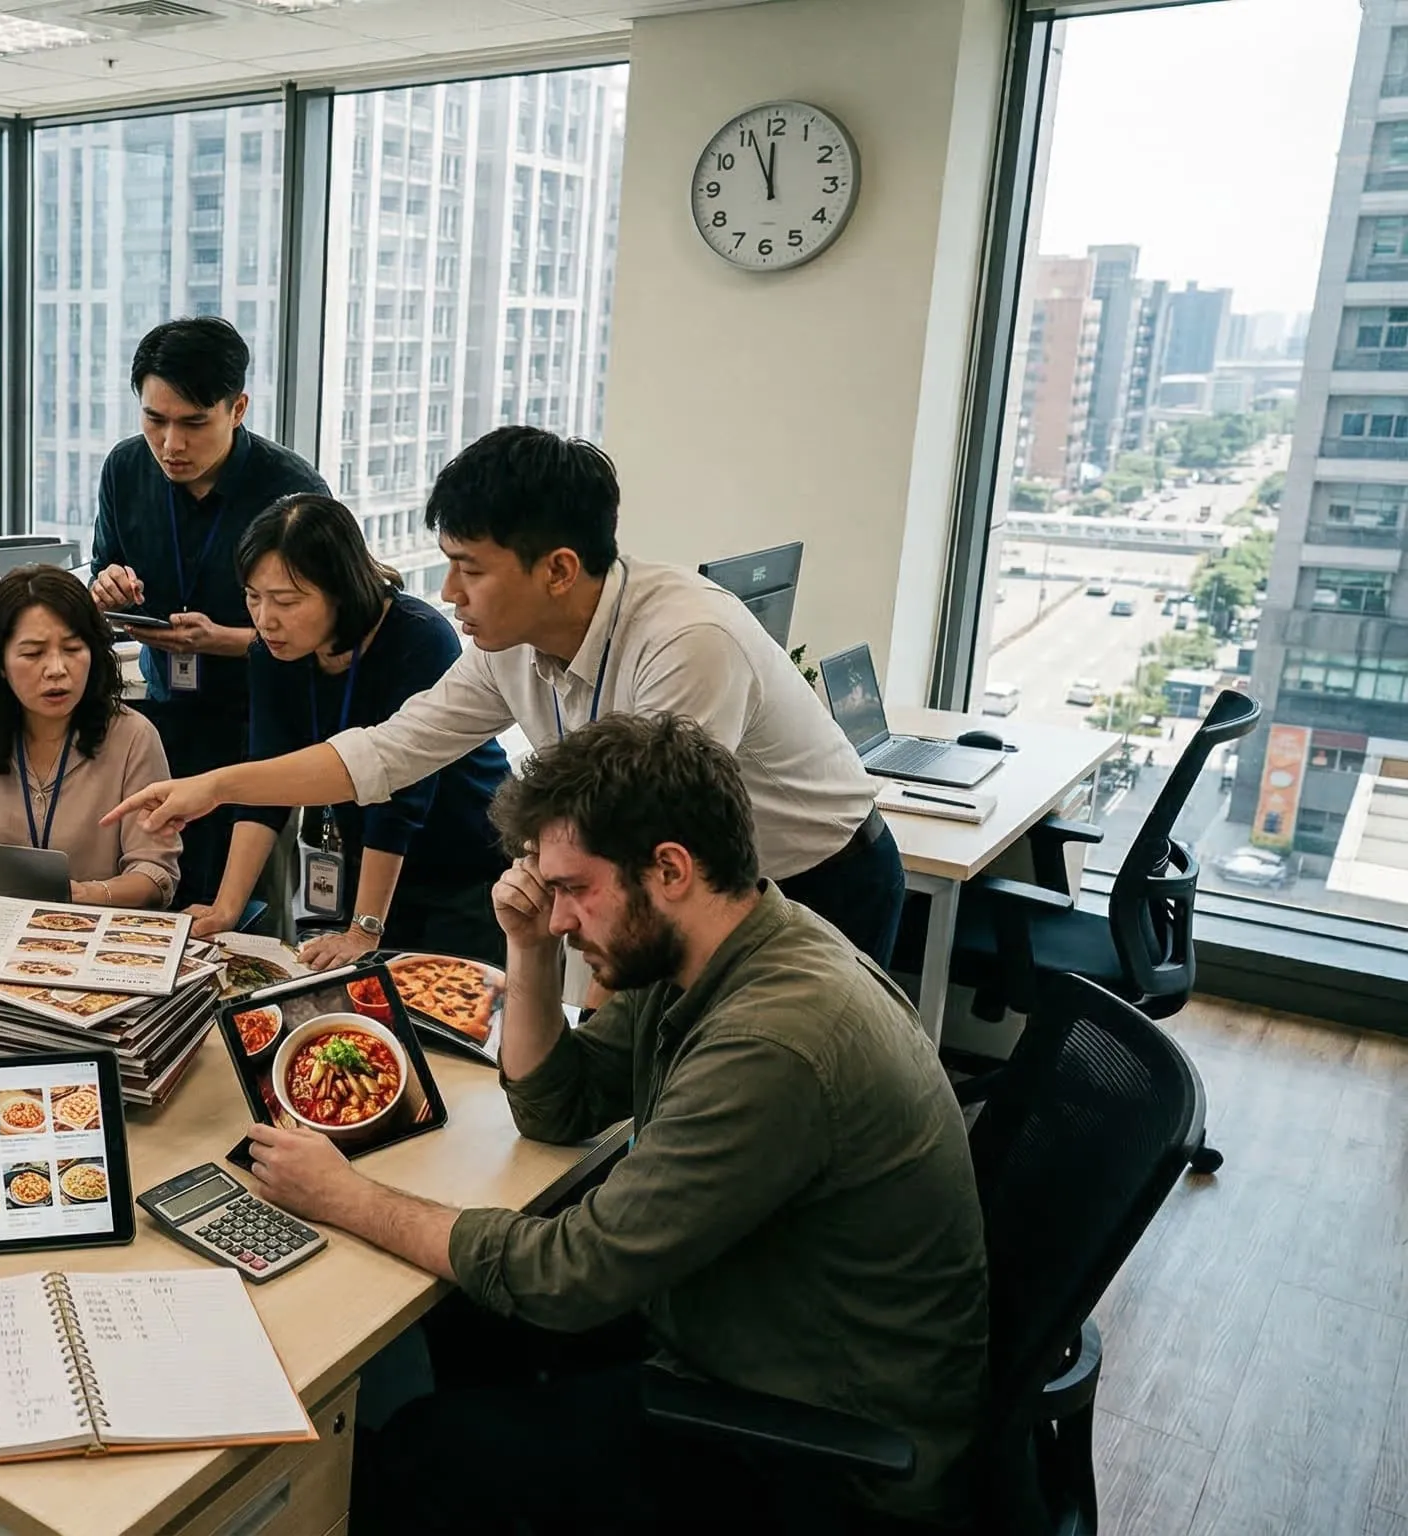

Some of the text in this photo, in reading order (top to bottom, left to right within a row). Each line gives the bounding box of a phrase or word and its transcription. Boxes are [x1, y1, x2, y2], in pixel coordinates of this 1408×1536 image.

[767, 118, 786, 136] 12
[803, 124, 809, 141] 1
[740, 130, 753, 147] 11
[717, 153, 735, 171] 10
[816, 145, 833, 163] 2
[706, 181, 721, 198] 9
[822, 176, 839, 194] 3
[712, 211, 727, 227] 8
[812, 207, 827, 224] 4
[732, 232, 747, 249] 7
[787, 229, 803, 247] 5
[758, 239, 773, 255] 6
